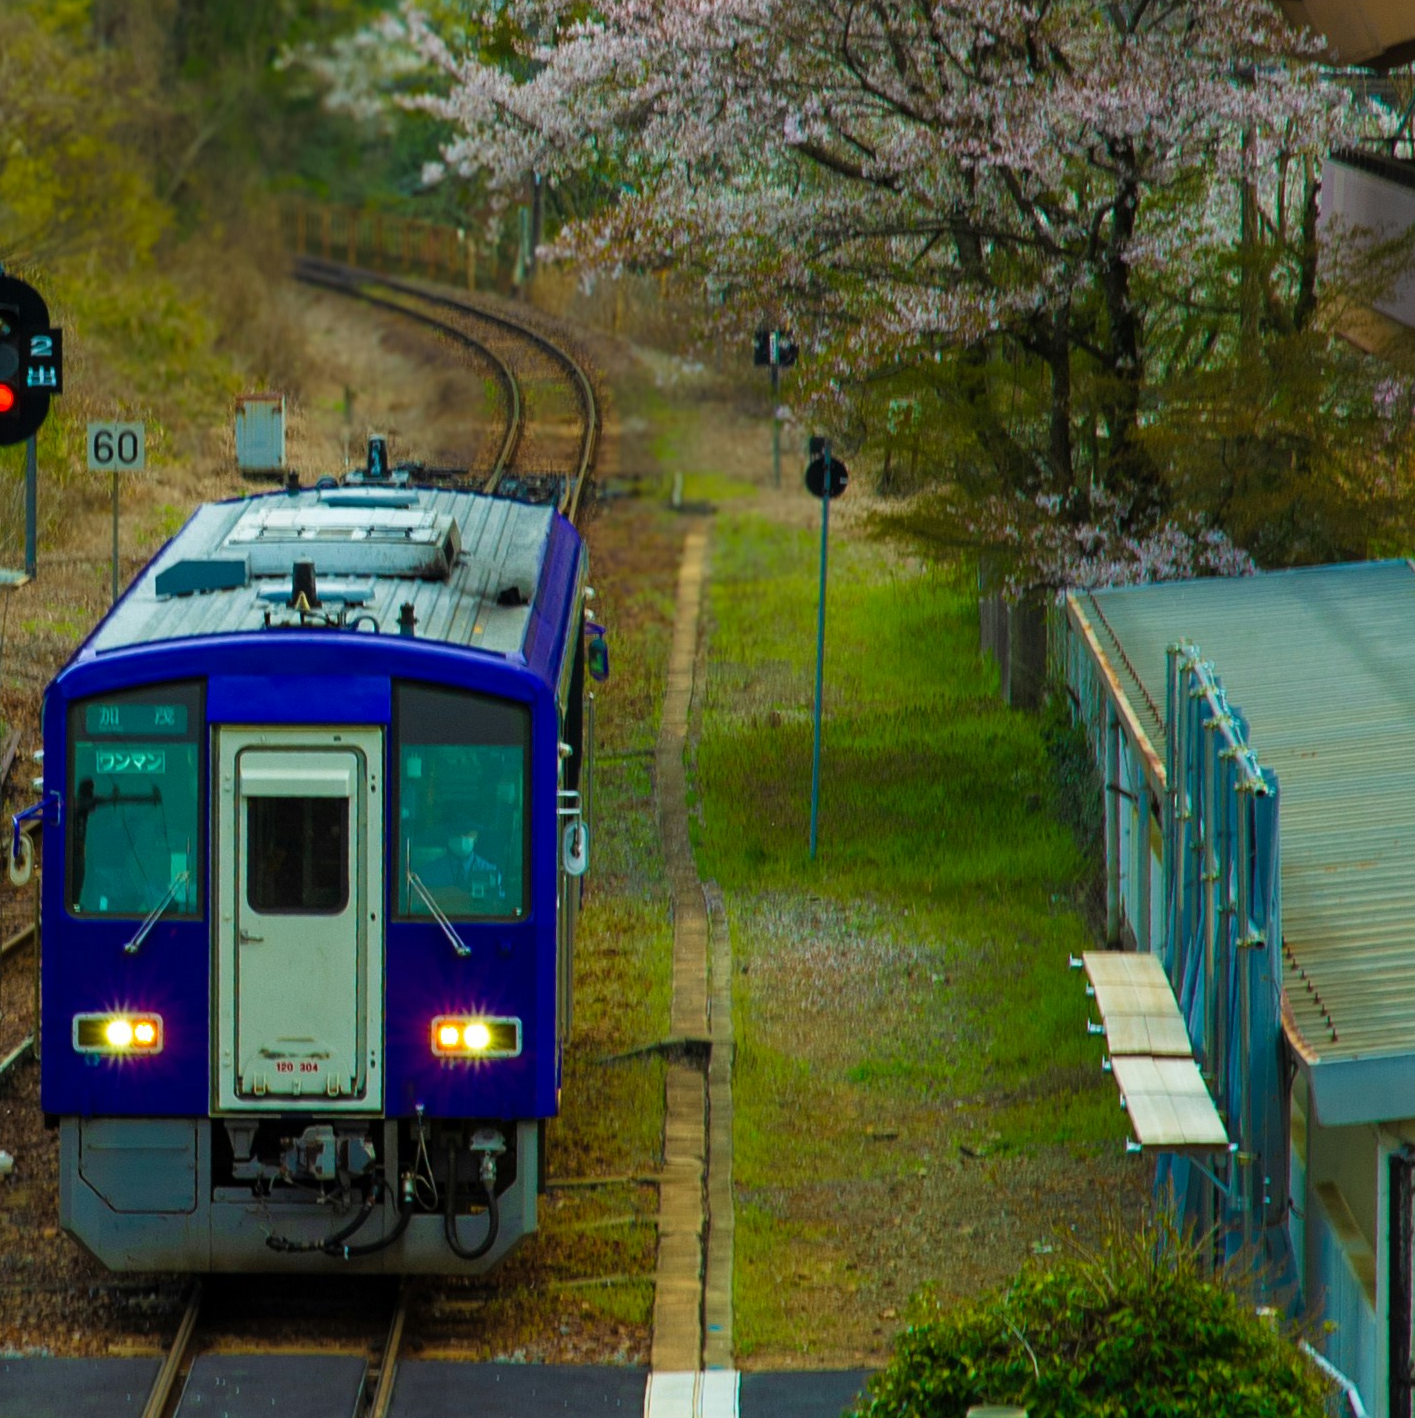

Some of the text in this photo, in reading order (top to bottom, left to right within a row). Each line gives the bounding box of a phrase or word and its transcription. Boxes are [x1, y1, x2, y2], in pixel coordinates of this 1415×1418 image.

[93, 429, 139, 464] 60
[100, 752, 162, 771] ワンマン
[276, 1062, 294, 1072] 120
